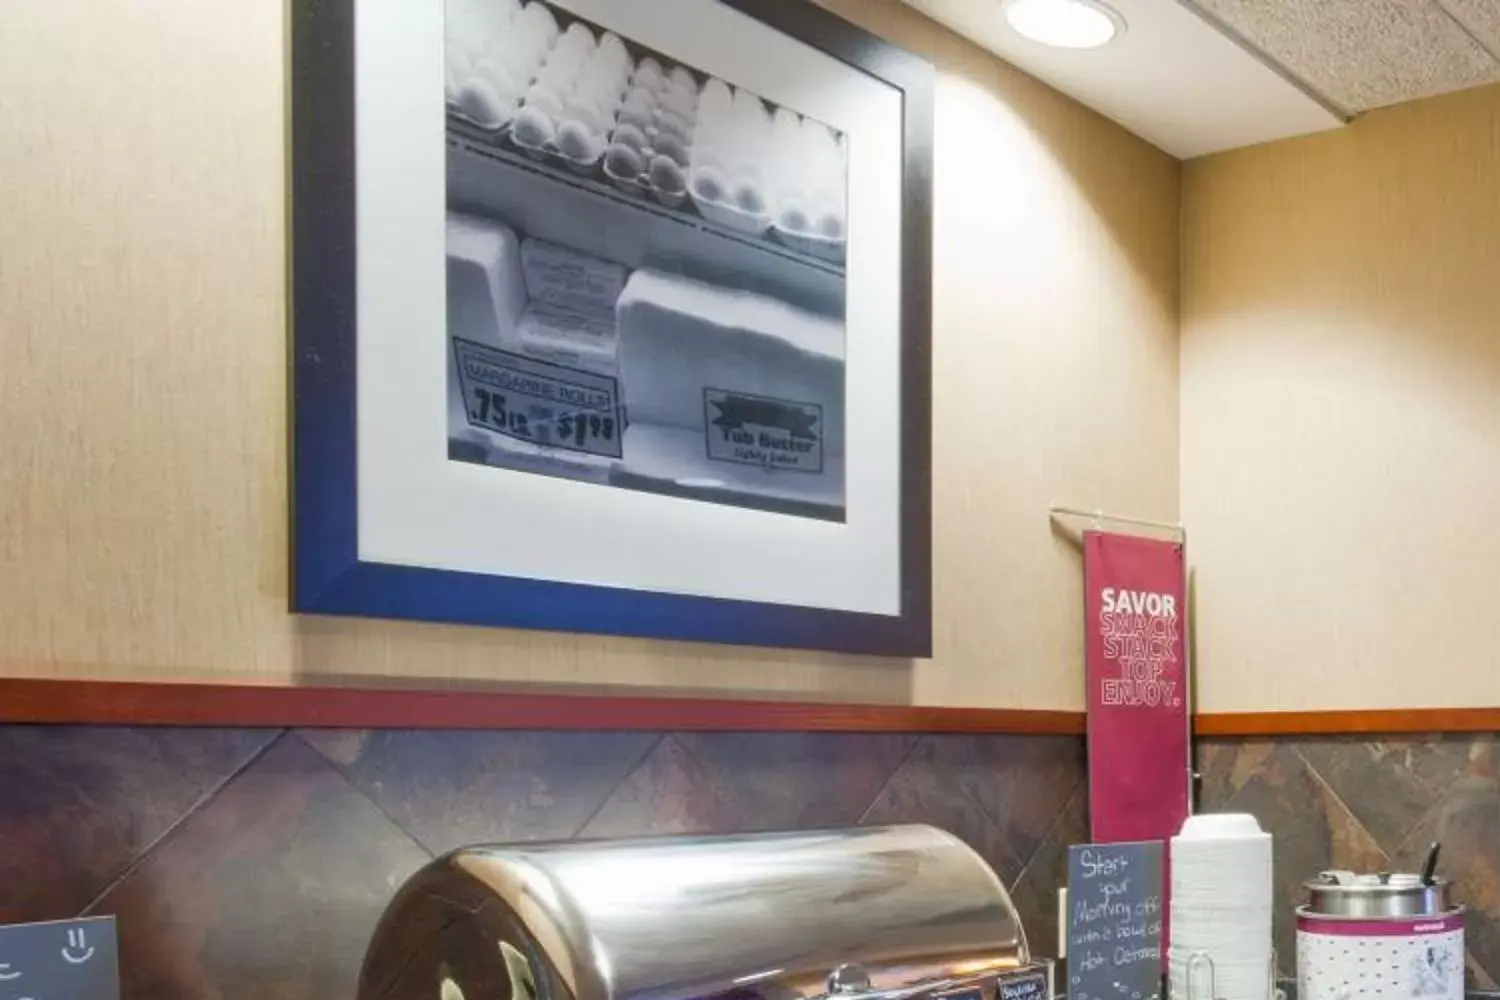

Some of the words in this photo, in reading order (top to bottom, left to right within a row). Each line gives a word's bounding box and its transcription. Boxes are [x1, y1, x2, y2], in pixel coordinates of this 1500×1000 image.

[1101, 587, 1177, 620] SAVOR
[1099, 612, 1179, 640] SNACK
[1103, 637, 1177, 662] STACK
[1118, 660, 1162, 681] TOP
[1080, 850, 1129, 879] Start
